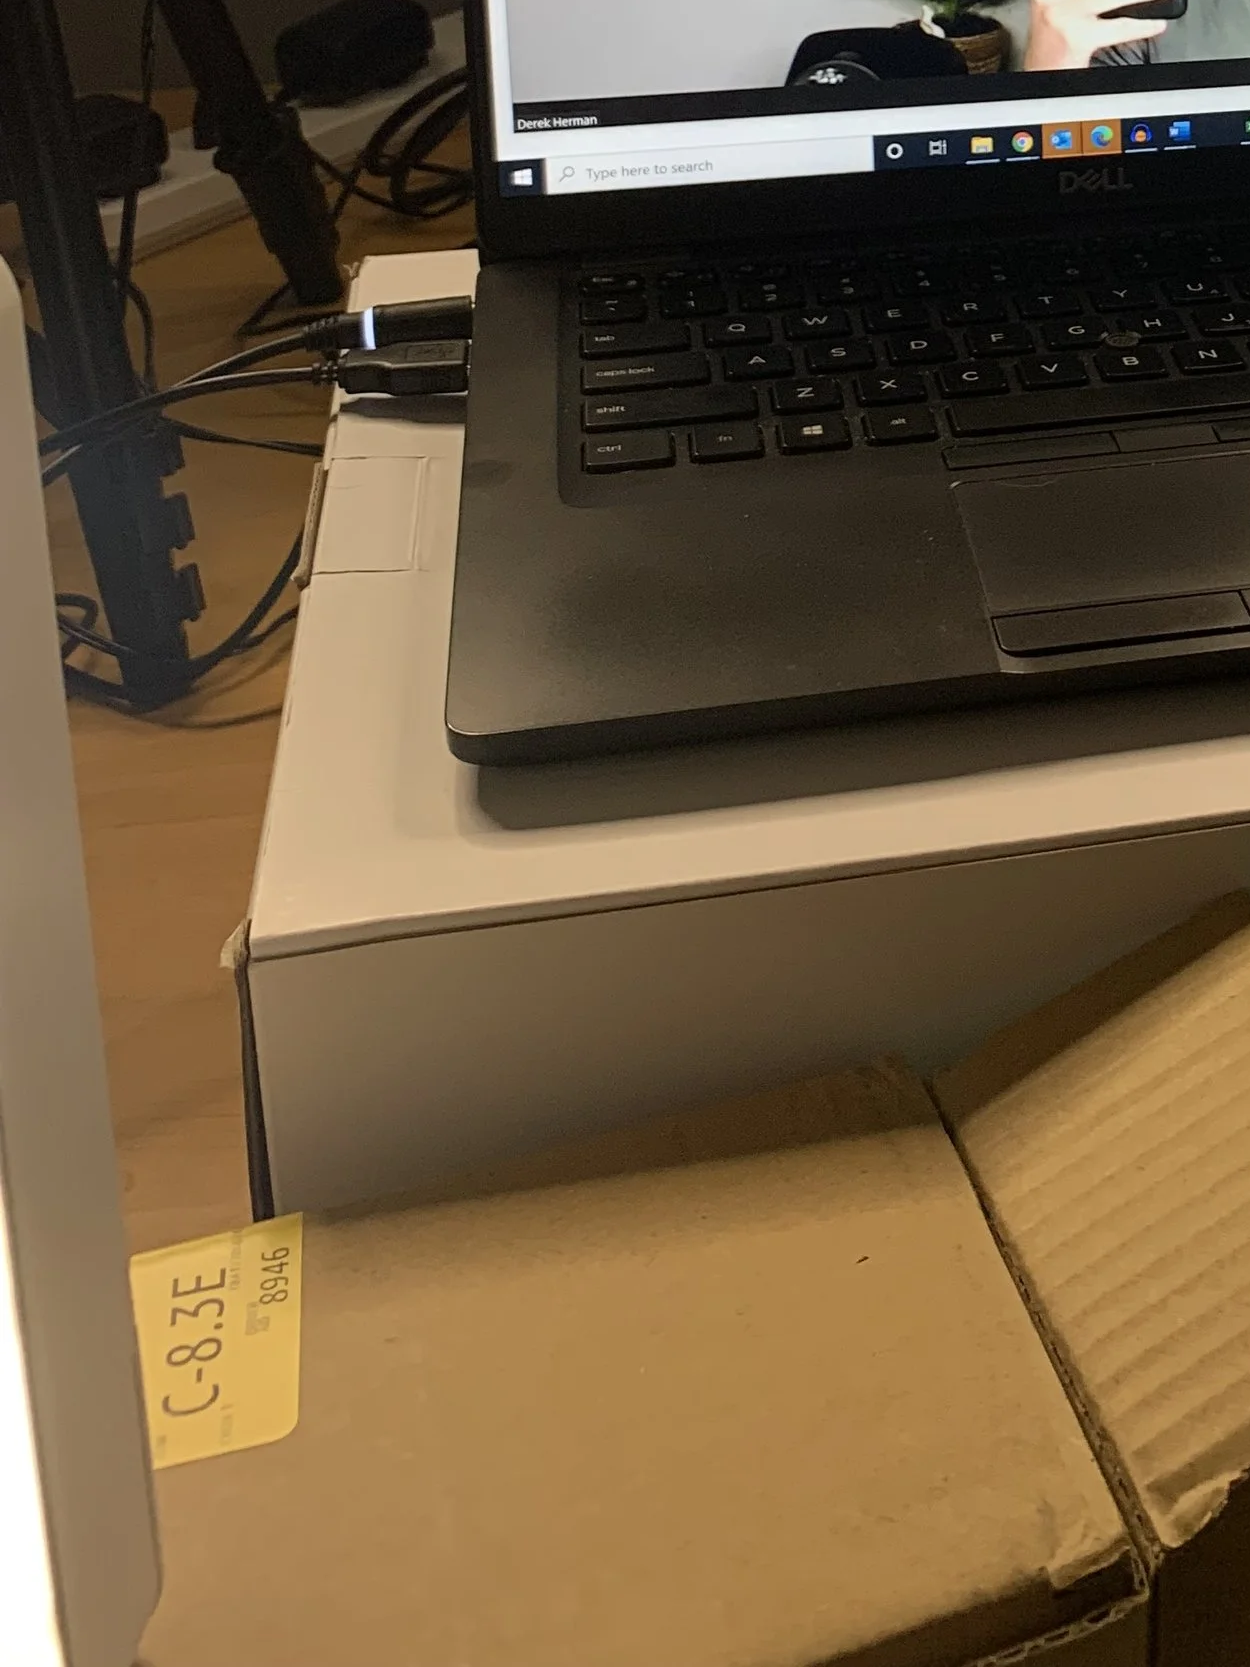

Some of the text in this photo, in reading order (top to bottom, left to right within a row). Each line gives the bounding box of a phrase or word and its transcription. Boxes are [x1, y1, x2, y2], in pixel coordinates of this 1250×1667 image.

[517, 114, 598, 131] Derek Herman
[586, 160, 713, 180] Type here to search
[1057, 167, 1134, 194] DELL
[1185, 282, 1204, 292] U
[1111, 288, 1128, 299] Y
[1036, 295, 1054, 305] T
[962, 301, 979, 312] R
[886, 307, 901, 319] E
[1220, 312, 1236, 322] J
[802, 314, 829, 326] W
[1143, 317, 1162, 329] H
[727, 322, 746, 333] Q
[1067, 324, 1086, 336] G
[990, 332, 1005, 343] F
[909, 339, 929, 351] D
[829, 346, 847, 358] S
[1197, 347, 1219, 359] N
[748, 354, 767, 366] A
[1121, 355, 1140, 367] B
[595, 365, 655, 378] caps lock
[1040, 361, 1059, 374] V
[961, 370, 980, 382] C
[880, 378, 898, 390] X
[796, 386, 815, 398] Z
[595, 404, 626, 415] shift
[597, 443, 622, 454] ctrl
[259, 1246, 290, 1305] 8946
[161, 1267, 227, 1417] C-8.3E
